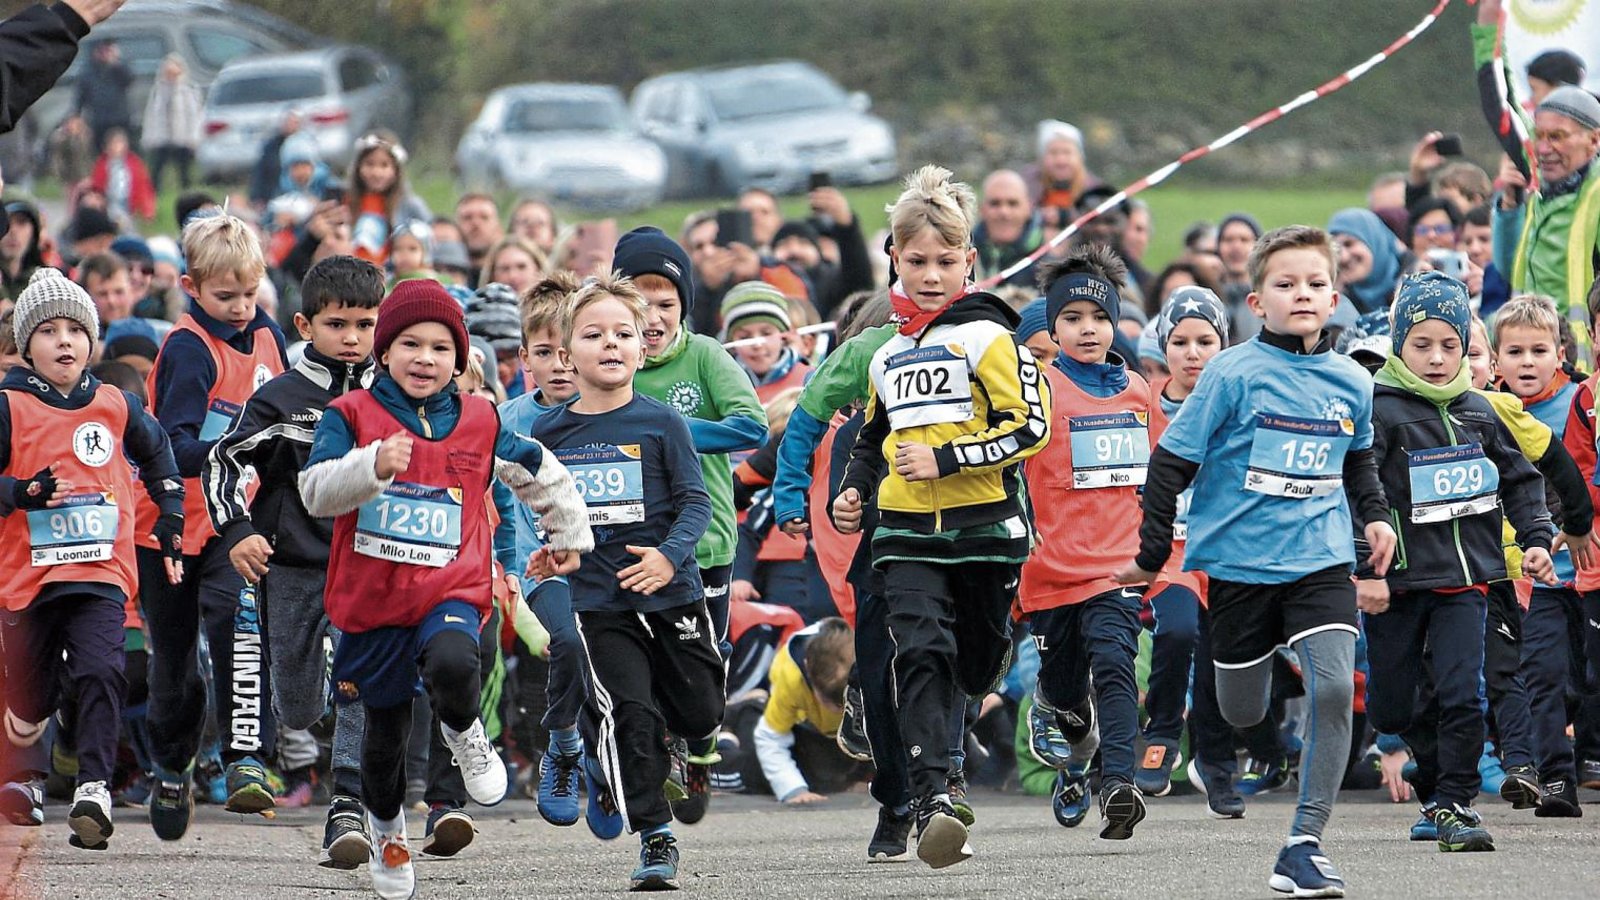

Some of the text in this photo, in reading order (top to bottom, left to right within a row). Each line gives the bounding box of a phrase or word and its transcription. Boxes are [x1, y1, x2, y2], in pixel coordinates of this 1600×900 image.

[894, 367, 952, 400] 1702
[291, 413, 316, 422] JAKO
[1095, 432, 1134, 461] 971
[1282, 439, 1331, 471] 156
[572, 468, 625, 498] 539
[1110, 473, 1130, 483] Nico
[1434, 464, 1483, 496] 629
[50, 510, 103, 539] 906
[376, 500, 448, 538] 1230
[56, 548, 101, 561] Leonard
[380, 543, 405, 558] Milo
[679, 632, 701, 641] adida
[231, 632, 262, 751] NINJAGO
